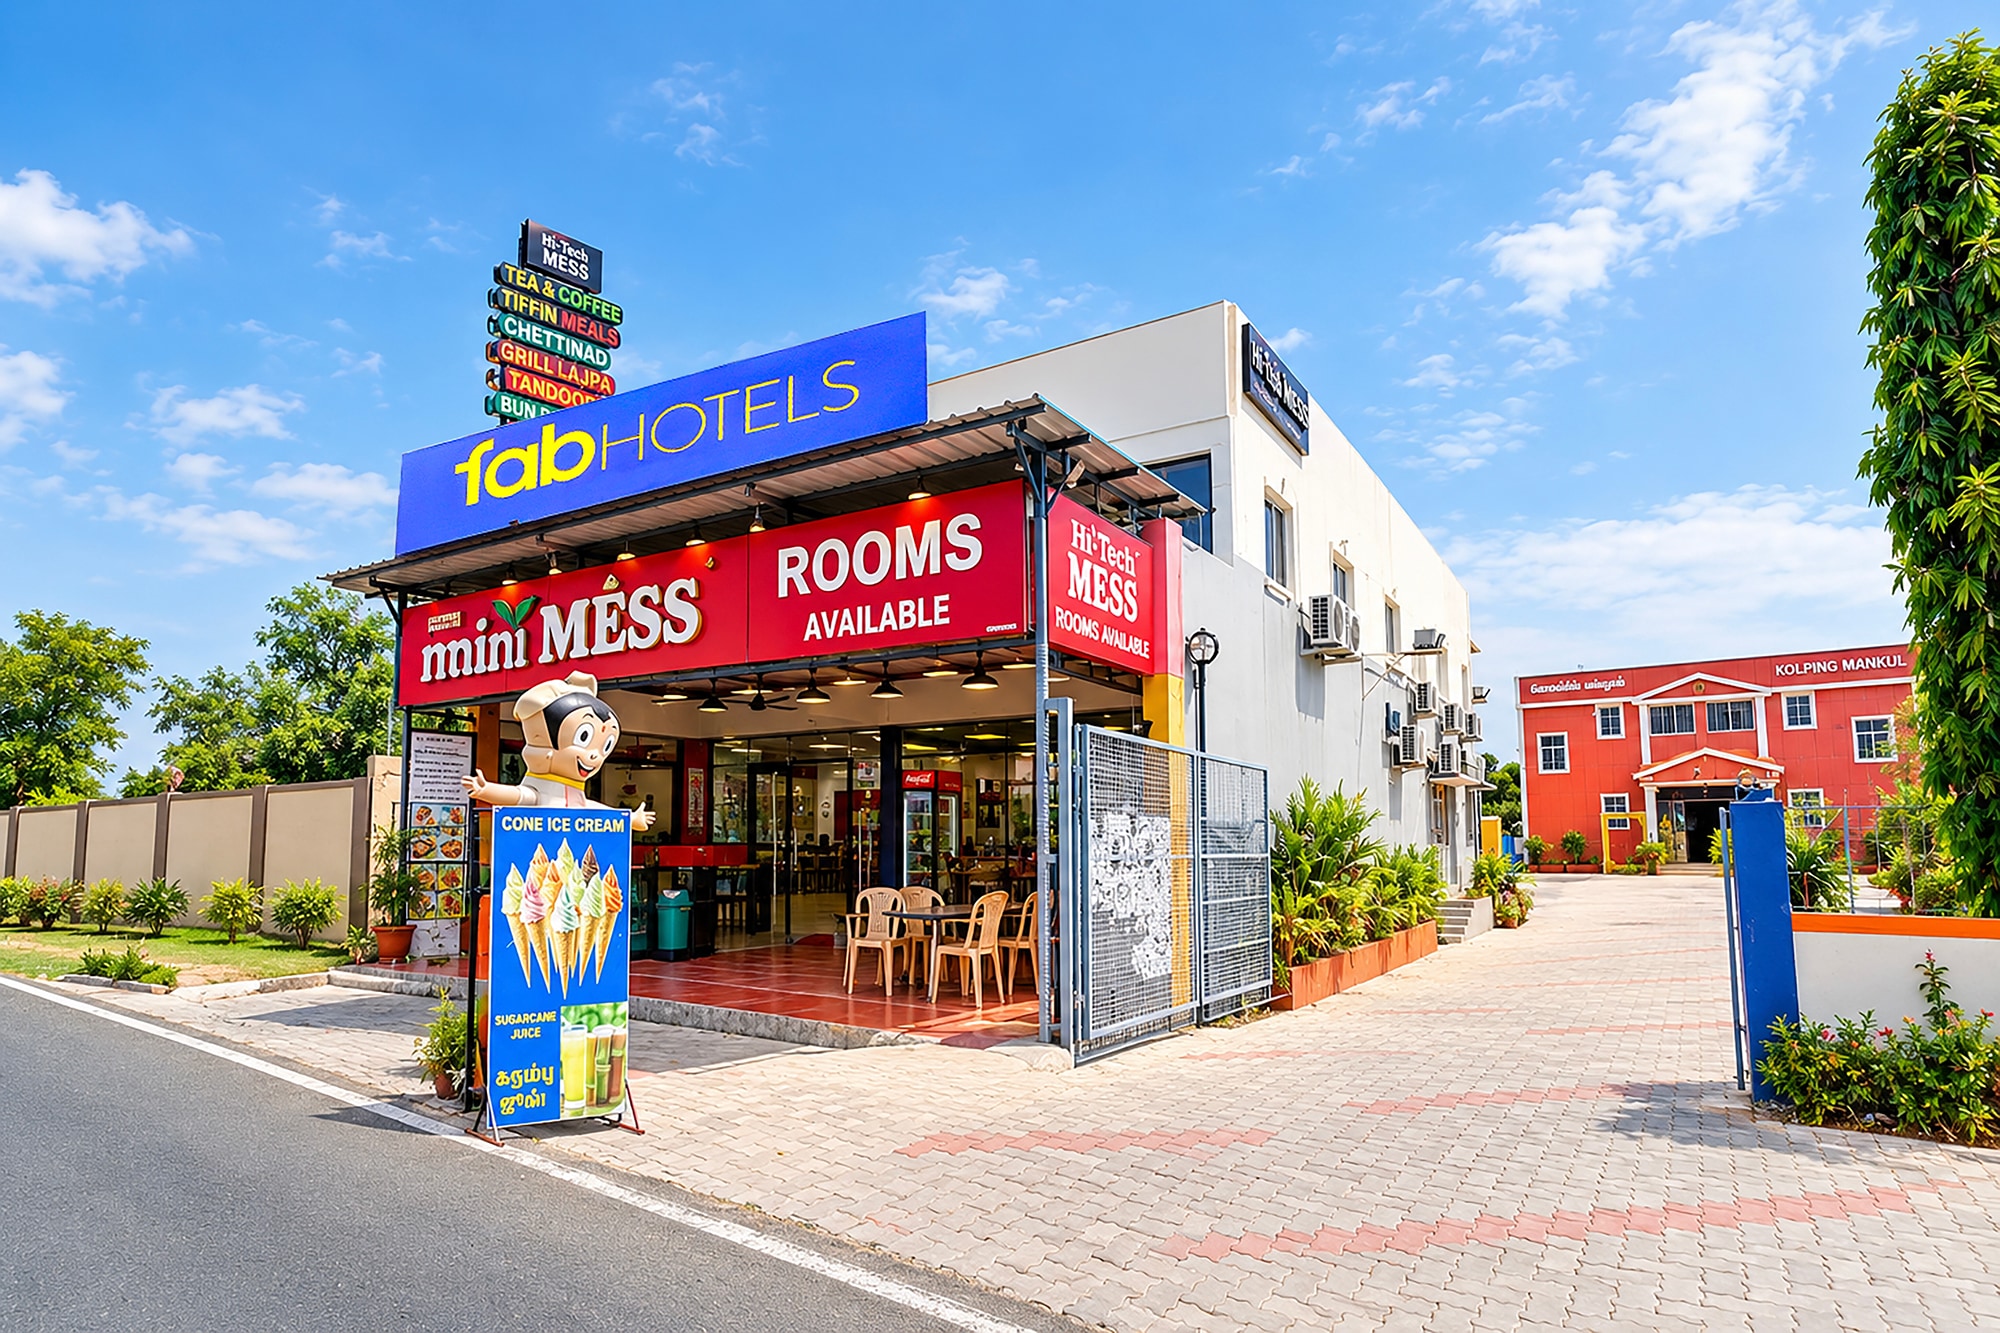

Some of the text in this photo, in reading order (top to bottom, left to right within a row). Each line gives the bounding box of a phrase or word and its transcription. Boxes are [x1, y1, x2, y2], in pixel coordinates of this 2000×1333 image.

[542, 232, 589, 263] Hi-Tech
[543, 248, 589, 280] MESS
[501, 289, 619, 348] TIFFIN MEALS
[504, 264, 621, 324] TEA & COFFEE
[504, 316, 608, 367] CHETTINAD
[501, 342, 612, 395] GRILL LAJPA
[501, 395, 536, 418] BUN
[777, 513, 983, 599] ROOMS
[1067, 550, 1138, 623] MESS
[420, 576, 702, 683] mini MESS
[803, 594, 950, 641] AVAILABLE
[1055, 605, 1150, 659] ROOMS AVAILABLE
[1775, 655, 1907, 676] KOLPING MANKUL
[502, 816, 624, 833] CONE ICE CREAM
[495, 1011, 556, 1026] SUGARCANE
[510, 1027, 541, 1040] JUICE
